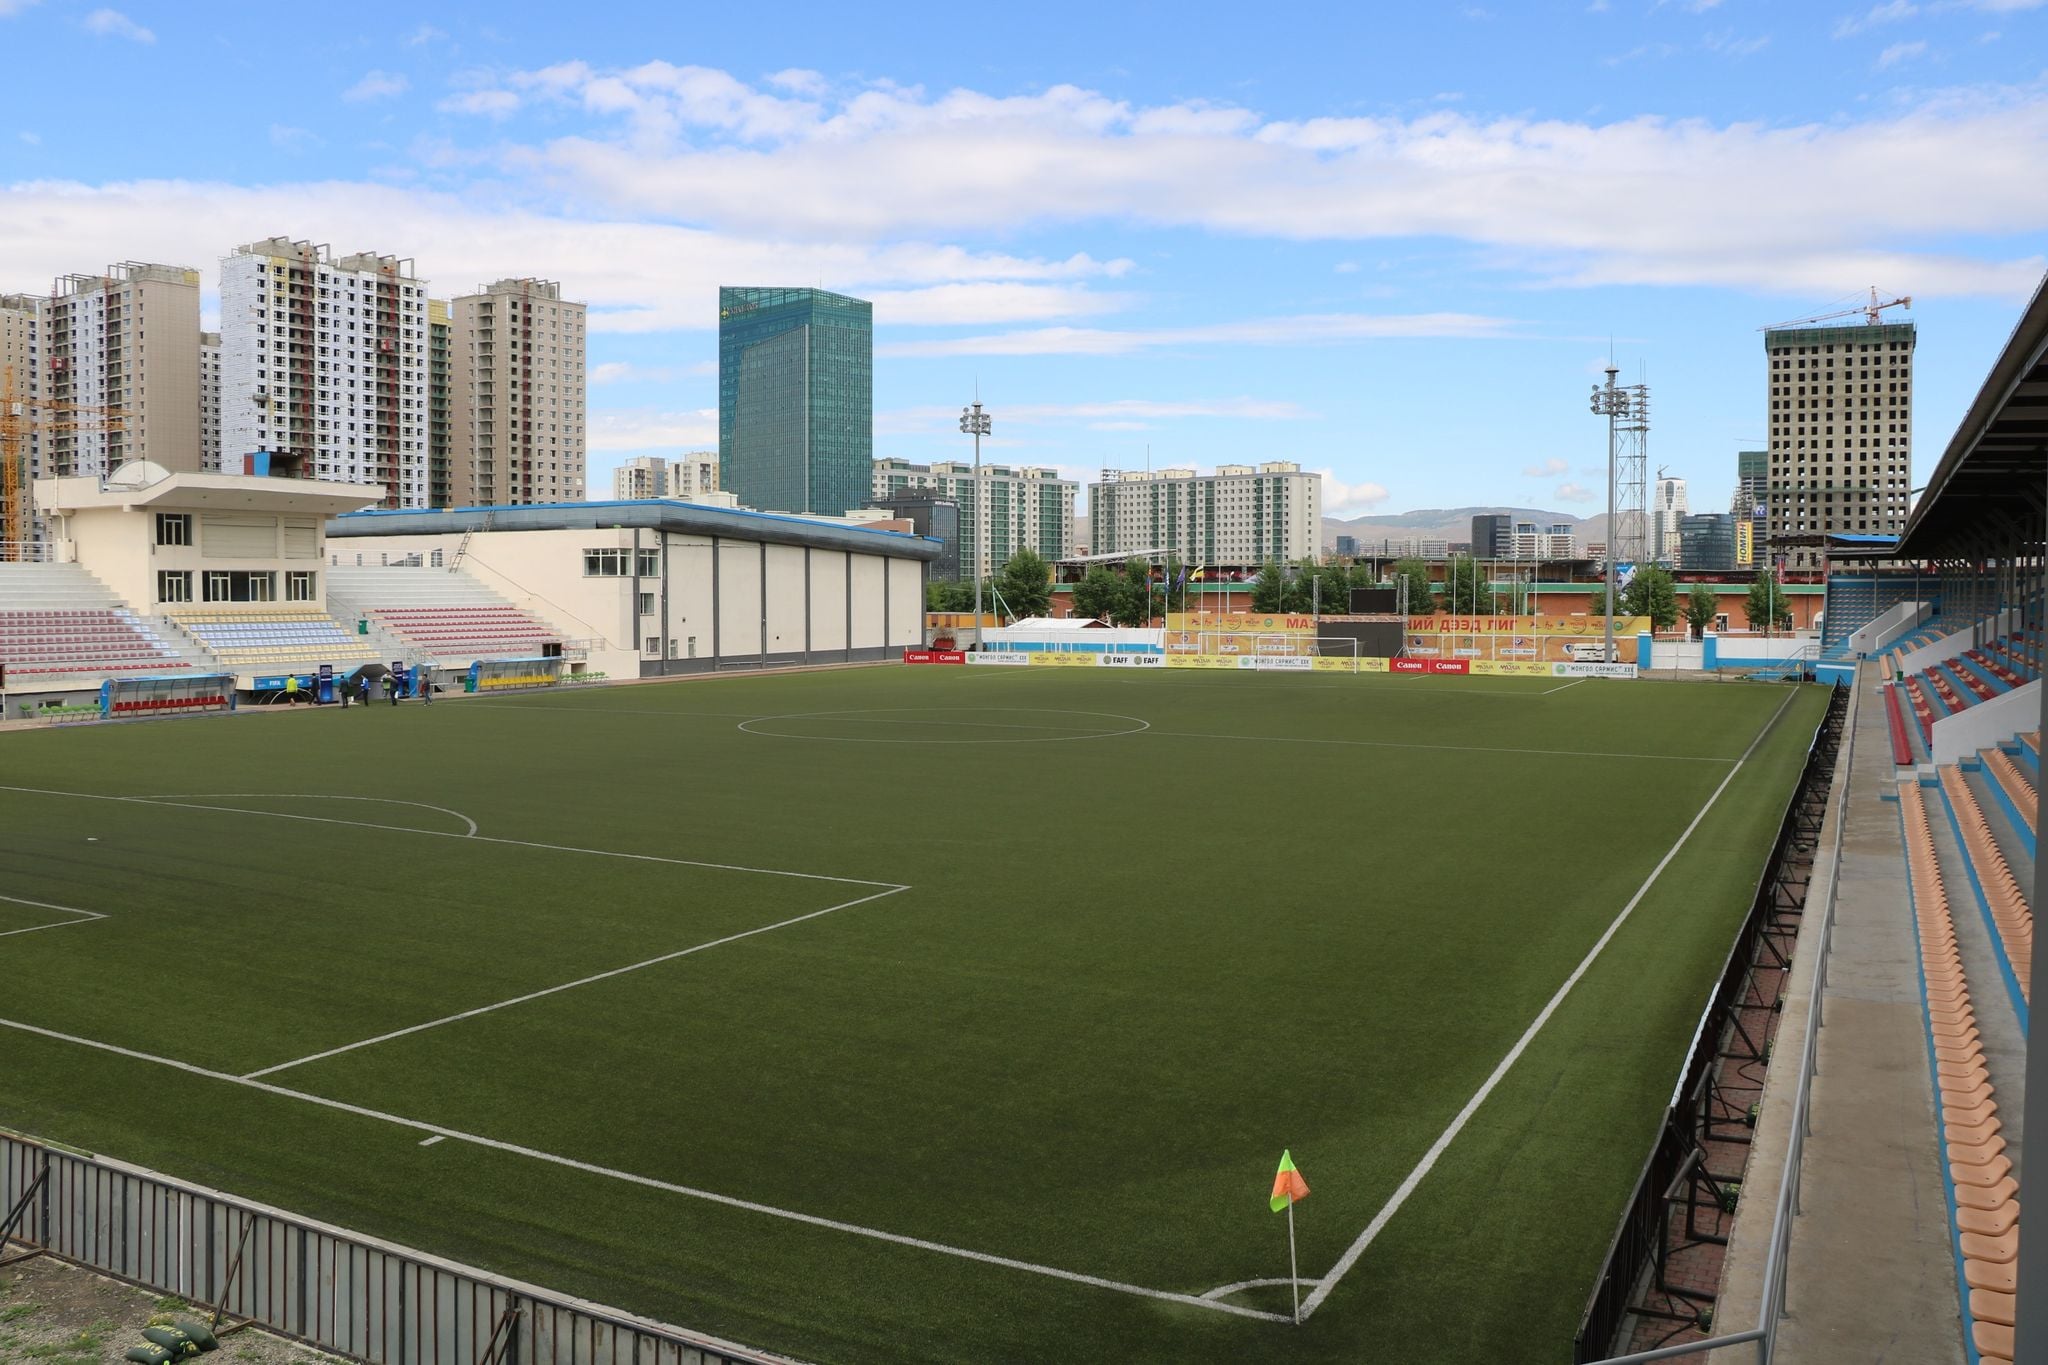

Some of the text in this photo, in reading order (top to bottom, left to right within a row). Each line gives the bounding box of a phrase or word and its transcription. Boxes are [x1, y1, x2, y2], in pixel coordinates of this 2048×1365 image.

[1440, 619, 1481, 632] ДЭЭД
[1112, 656, 1129, 664] EAFF
[1397, 661, 1422, 669] Canon
[1436, 662, 1462, 670] Canon
